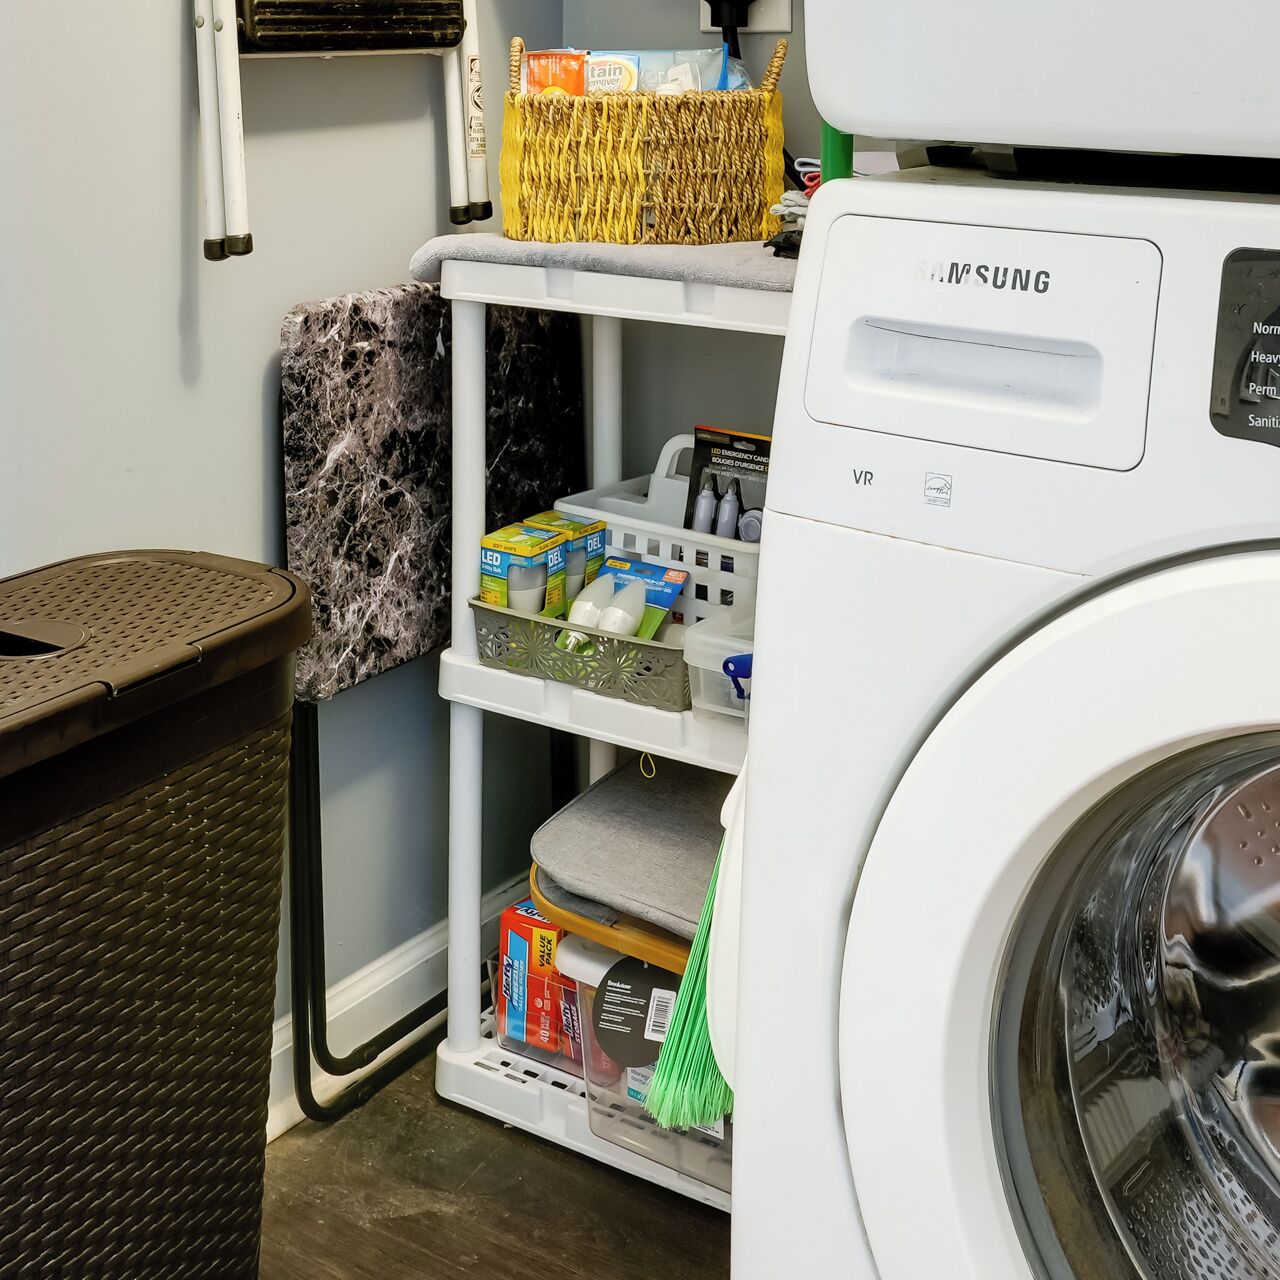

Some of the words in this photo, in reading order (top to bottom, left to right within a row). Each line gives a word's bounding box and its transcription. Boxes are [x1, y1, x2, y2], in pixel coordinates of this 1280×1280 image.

[1249, 383, 1277, 395] Perm
[722, 450, 753, 460] EMERGENCY
[712, 457, 734, 465] BOUGIES
[735, 461, 764, 471] D'URGENCE
[853, 469, 873, 485] VR
[587, 536, 601, 551] DEL
[482, 549, 501, 566] LED
[548, 551, 562, 567] DEL
[503, 955, 512, 1000] Hefty
[560, 1000, 570, 1037] Hefty
[571, 1006, 581, 1044] STORAGE
[539, 1031, 549, 1043] 40
